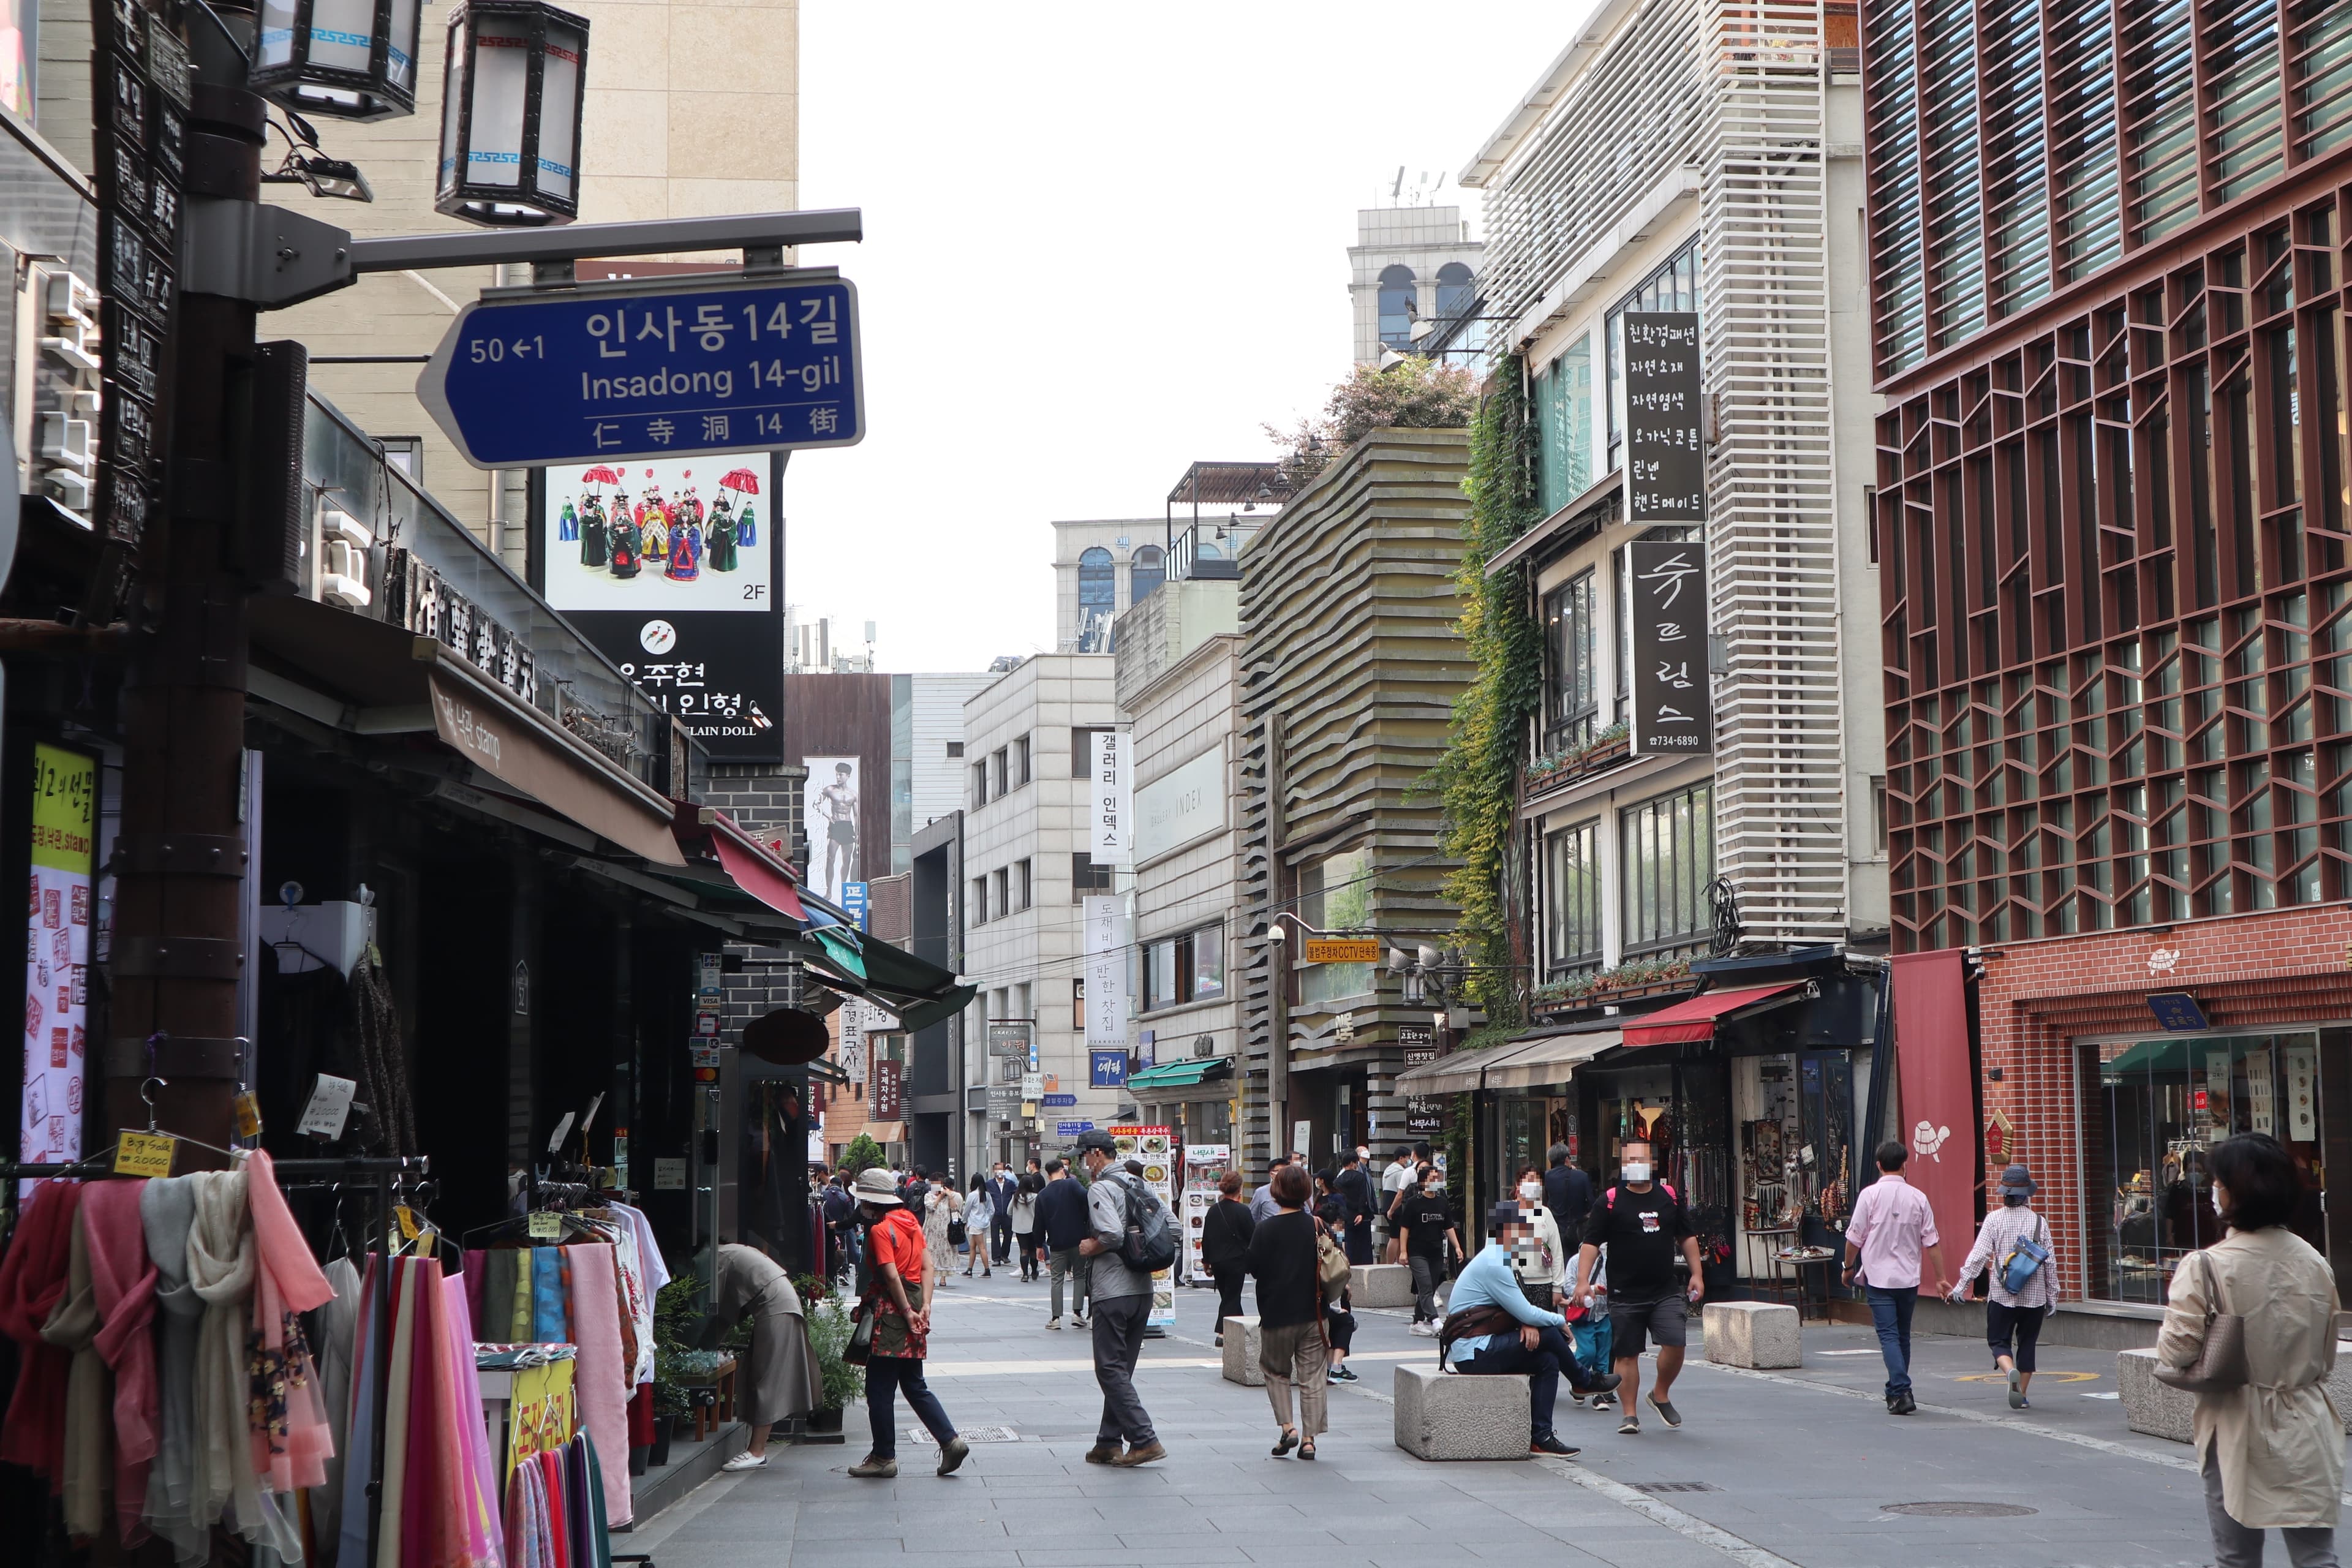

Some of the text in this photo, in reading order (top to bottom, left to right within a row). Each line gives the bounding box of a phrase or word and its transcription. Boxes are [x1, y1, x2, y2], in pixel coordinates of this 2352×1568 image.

[586, 296, 839, 358] 인사동14길
[1629, 323, 1695, 348] 친환경패션
[471, 336, 544, 364] 50 1
[582, 356, 840, 401] Insadong 14-gil
[1632, 392, 1684, 412] 자연염색
[1634, 459, 1659, 480] 린넨
[1634, 491, 1699, 511] 핸드메이드
[743, 584, 766, 601] 2F
[722, 726, 756, 736] DOLL
[1657, 736, 1698, 745] 734-6890
[476, 722, 500, 769] stamp
[1102, 735, 1117, 846] 갤러리 인덱스
[1176, 786, 1201, 819] INDEX
[880, 1067, 889, 1112] 국제자수원
[1410, 1118, 1436, 1129] 나무새
[148, 1139, 171, 1152] Sale
[1193, 1148, 1215, 1157] 나무새
